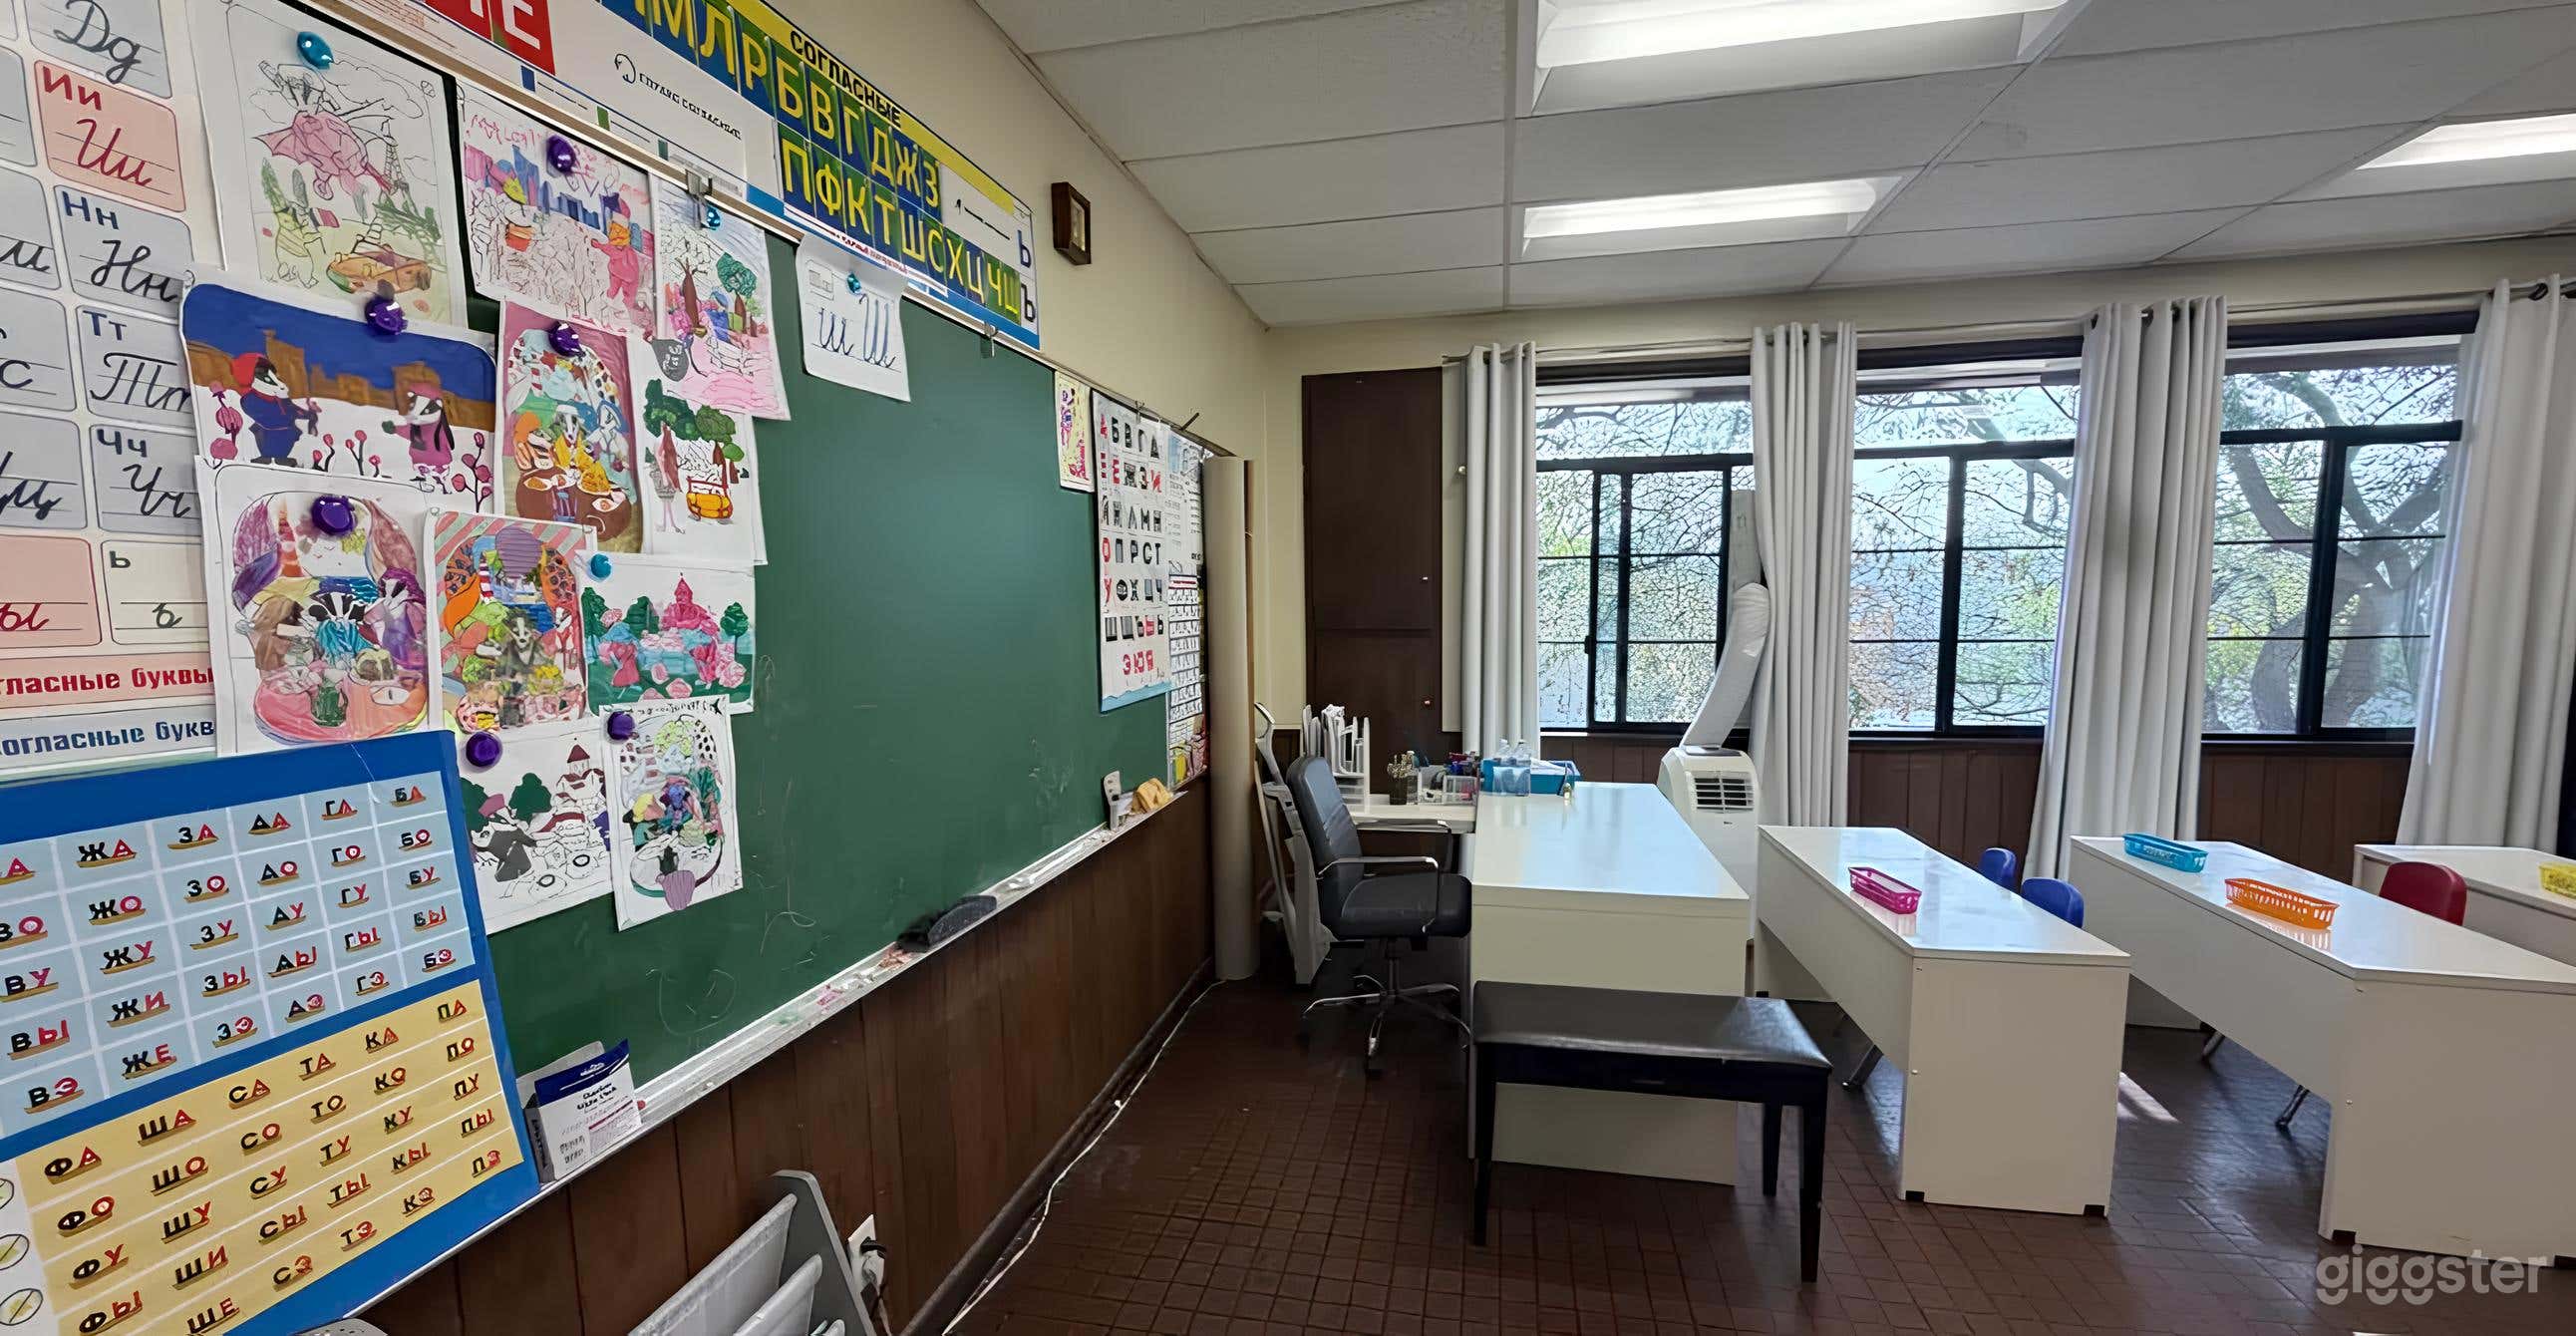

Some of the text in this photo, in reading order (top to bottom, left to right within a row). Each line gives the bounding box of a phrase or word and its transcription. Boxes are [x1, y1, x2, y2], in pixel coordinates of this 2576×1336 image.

[43, 66, 102, 111] Ии
[791, 31, 901, 128] СОГЛАСНЫЕ
[62, 191, 119, 229] Нн
[83, 310, 127, 341] Тт
[97, 429, 148, 458] Чч
[0, 727, 146, 756] огласные
